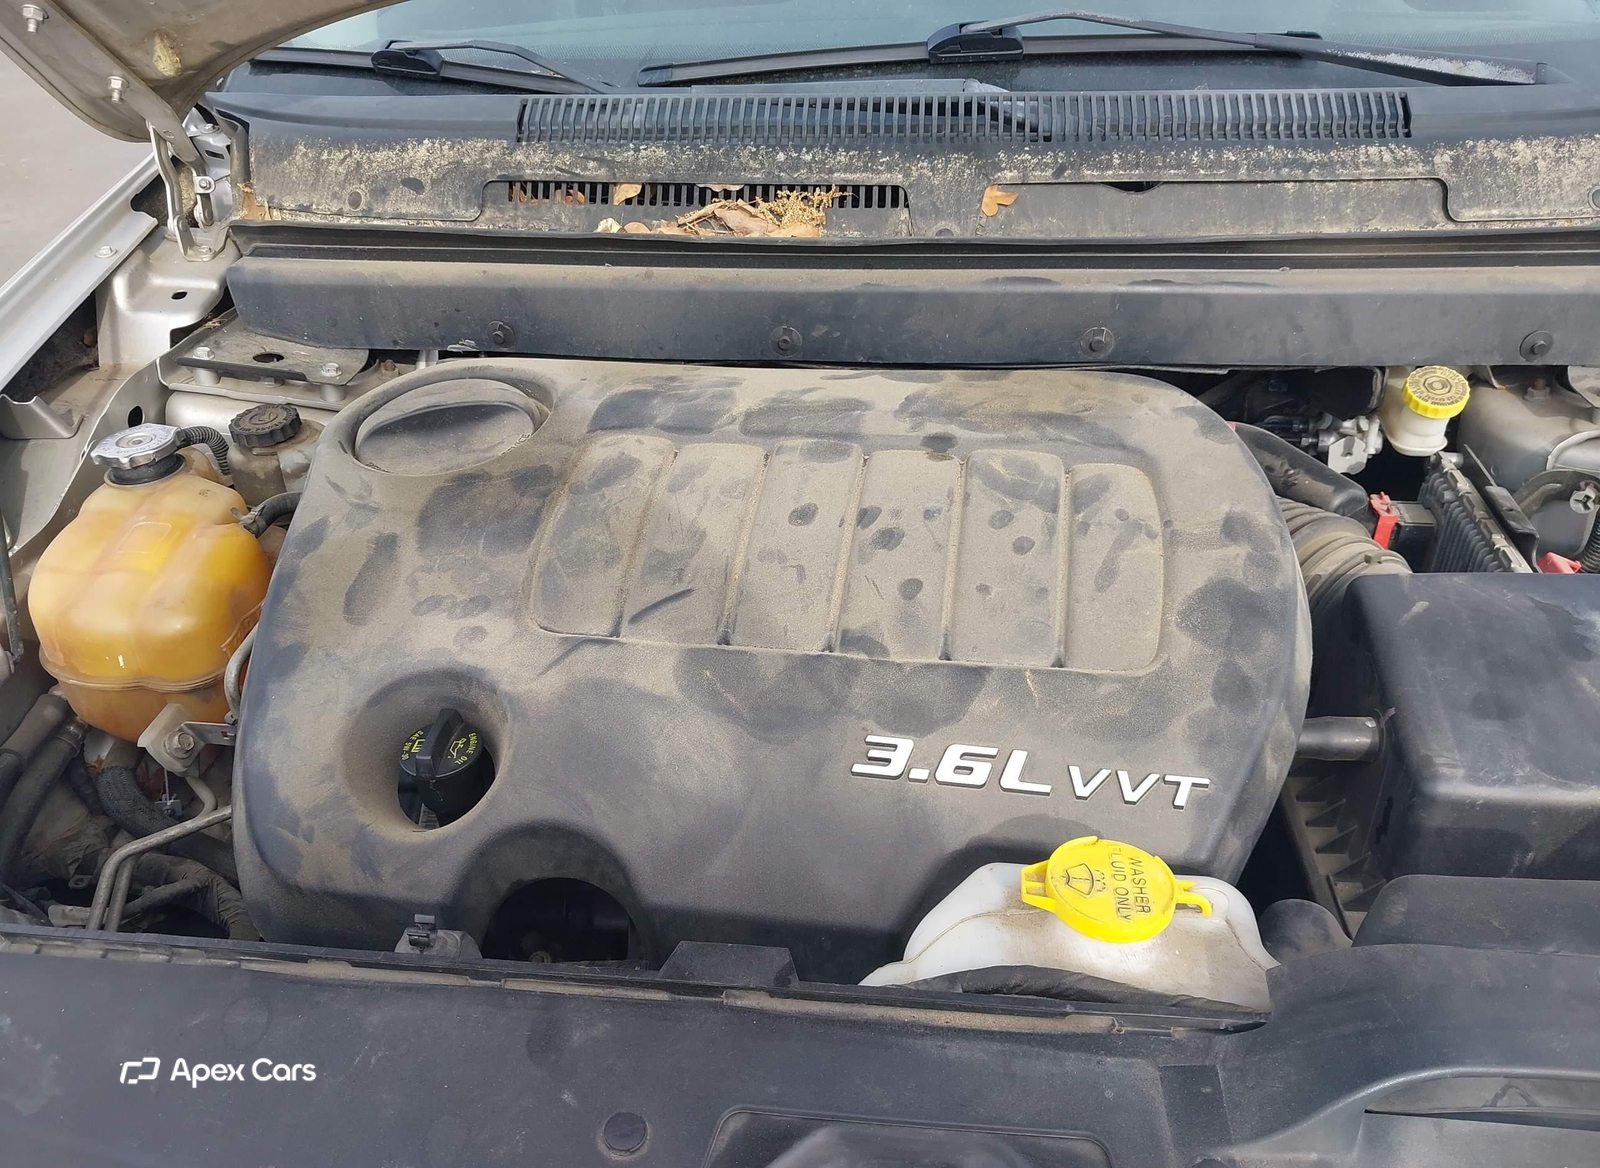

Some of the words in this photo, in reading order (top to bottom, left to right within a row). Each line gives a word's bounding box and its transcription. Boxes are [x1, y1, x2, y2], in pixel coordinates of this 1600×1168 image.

[454, 756, 468, 765] OIL
[466, 732, 478, 754] ENGINE
[851, 735, 1052, 797] 3.6L
[1068, 765, 1211, 810] VVT
[1107, 845, 1126, 882] FLUID
[1129, 856, 1151, 914] WASHER
[1115, 886, 1133, 923] ONLY
